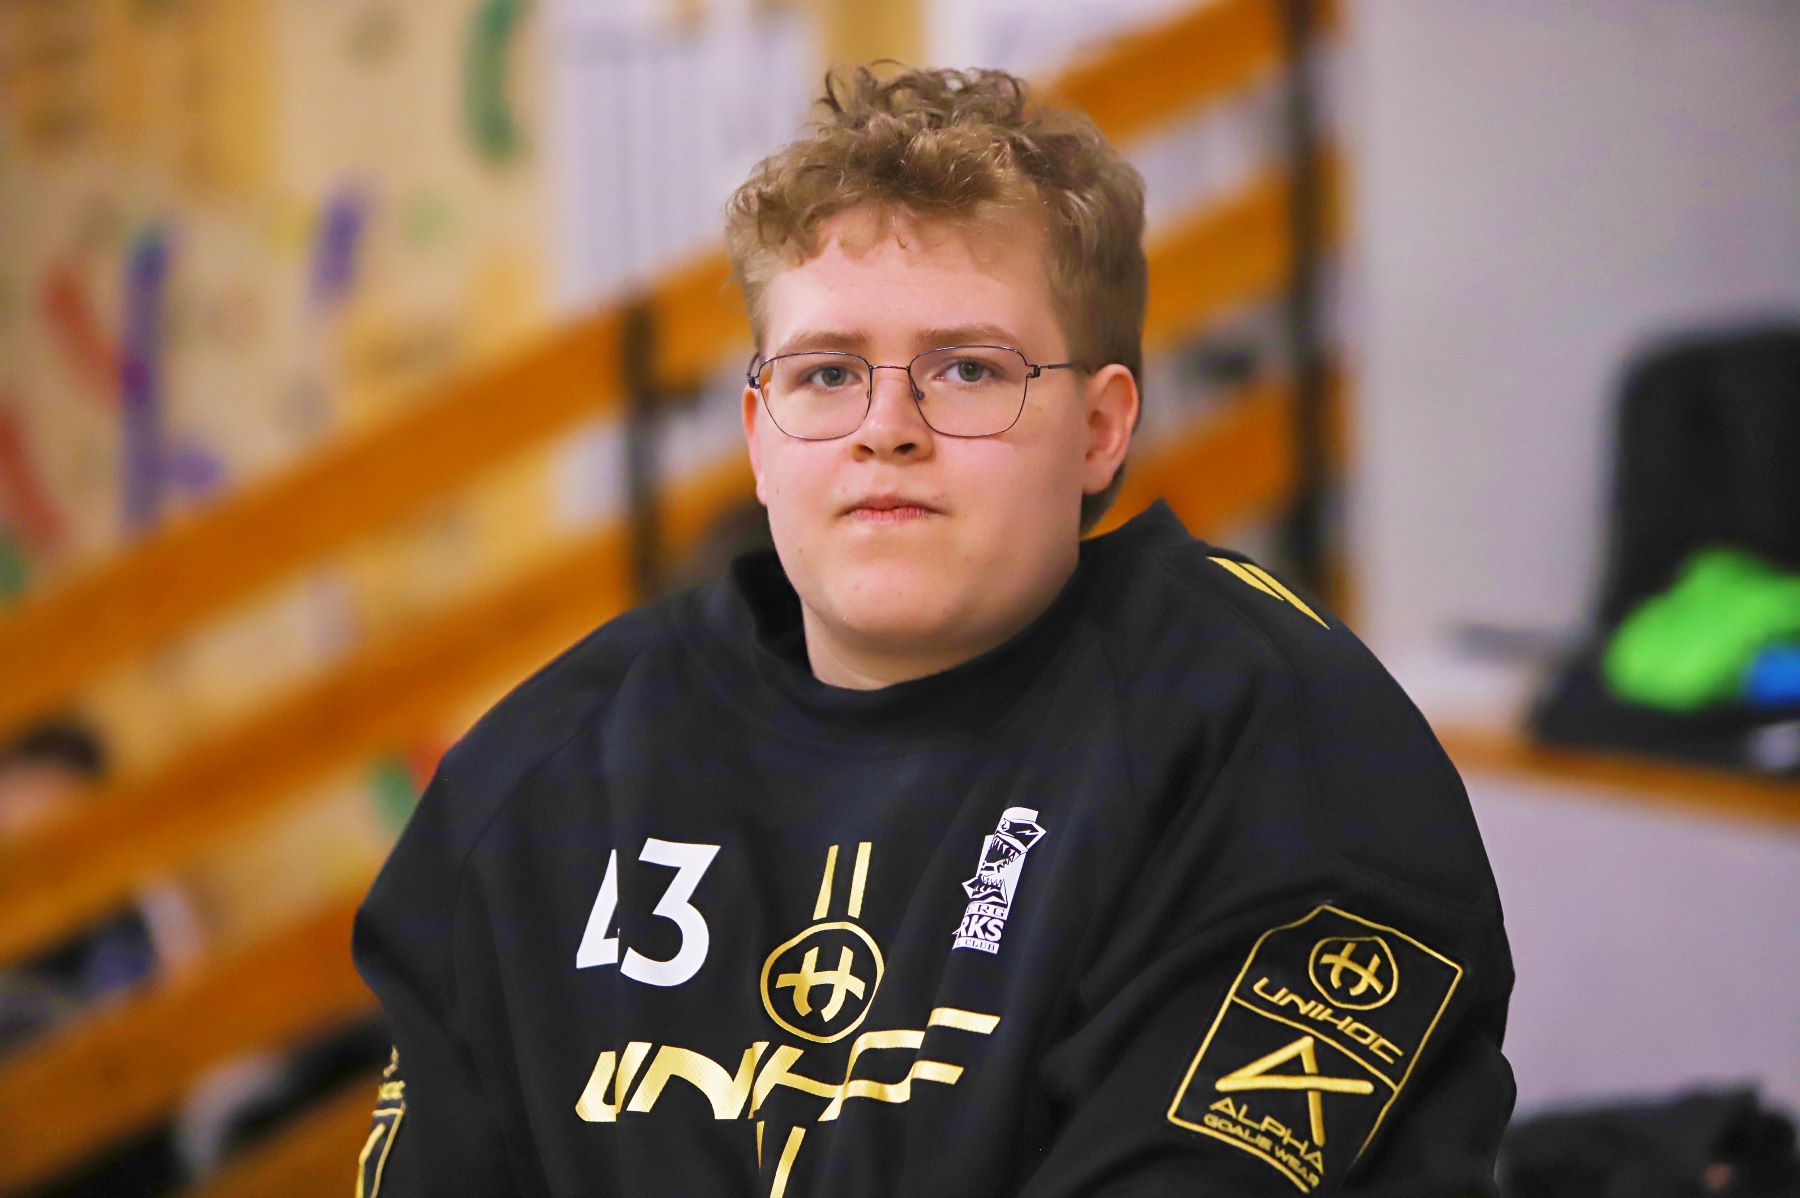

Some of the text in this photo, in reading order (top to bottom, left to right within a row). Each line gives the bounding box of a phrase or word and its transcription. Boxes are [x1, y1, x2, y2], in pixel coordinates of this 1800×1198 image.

[952, 914, 1004, 942] RKS
[1252, 976, 1404, 1065] UNIHOC
[1203, 1112, 1321, 1189] GOALIE WEAR
[1209, 1096, 1325, 1175] ALPHA
